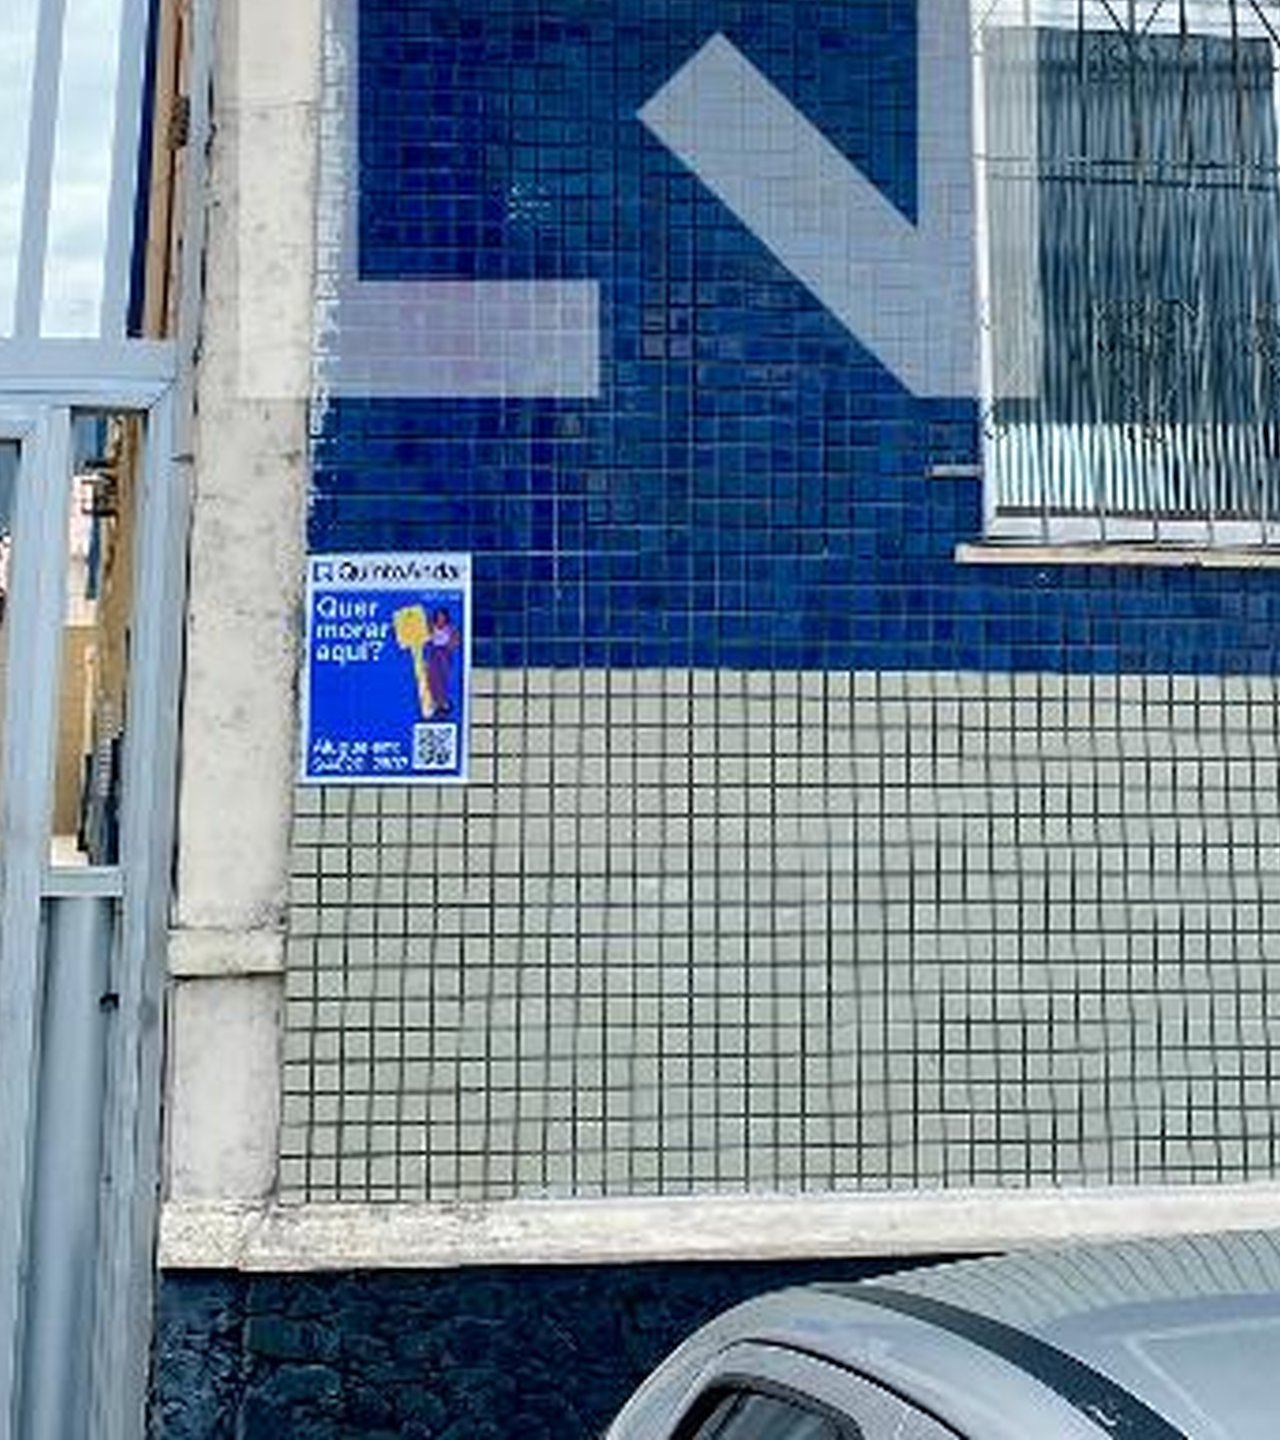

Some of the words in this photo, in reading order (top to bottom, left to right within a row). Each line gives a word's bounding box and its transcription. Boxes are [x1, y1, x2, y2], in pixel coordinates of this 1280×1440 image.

[316, 596, 379, 619] Quer
[316, 621, 389, 639] morar
[316, 641, 382, 668] aqui?
